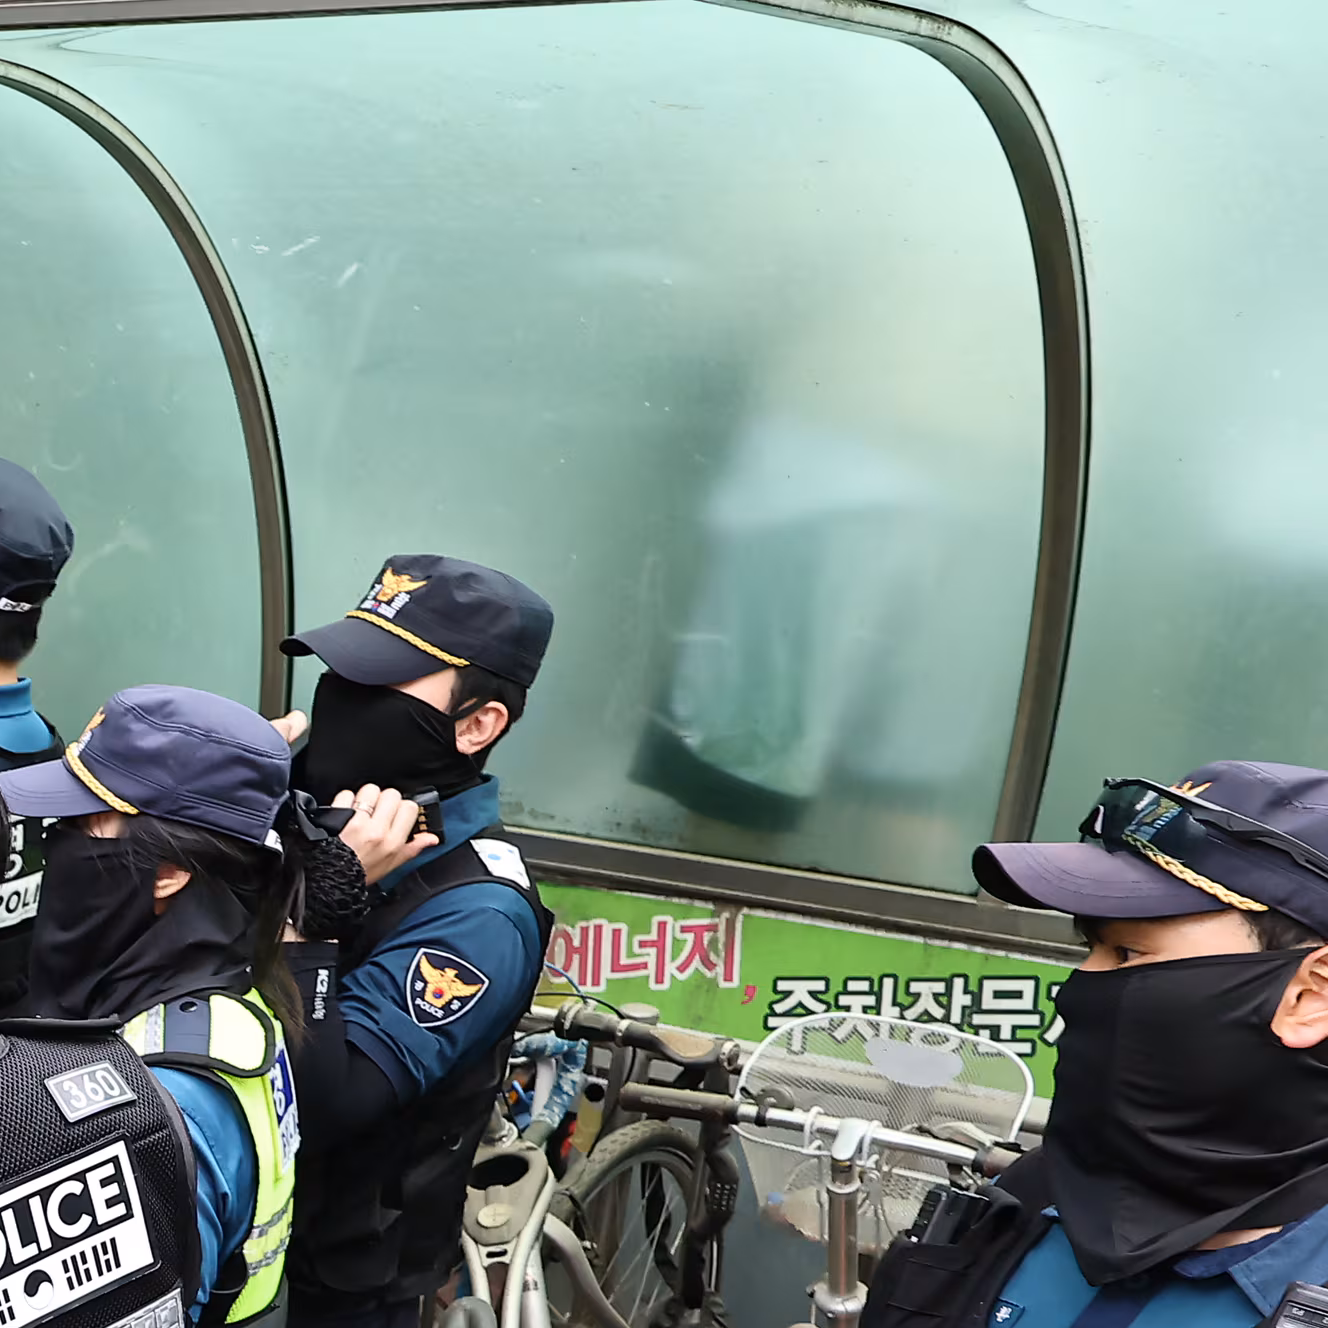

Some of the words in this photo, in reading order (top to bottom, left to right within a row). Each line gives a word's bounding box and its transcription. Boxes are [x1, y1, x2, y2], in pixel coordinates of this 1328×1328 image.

[414, 997, 445, 1018] POLICE
[765, 975, 1066, 1055] 주차장문
[62, 1069, 121, 1110] 360
